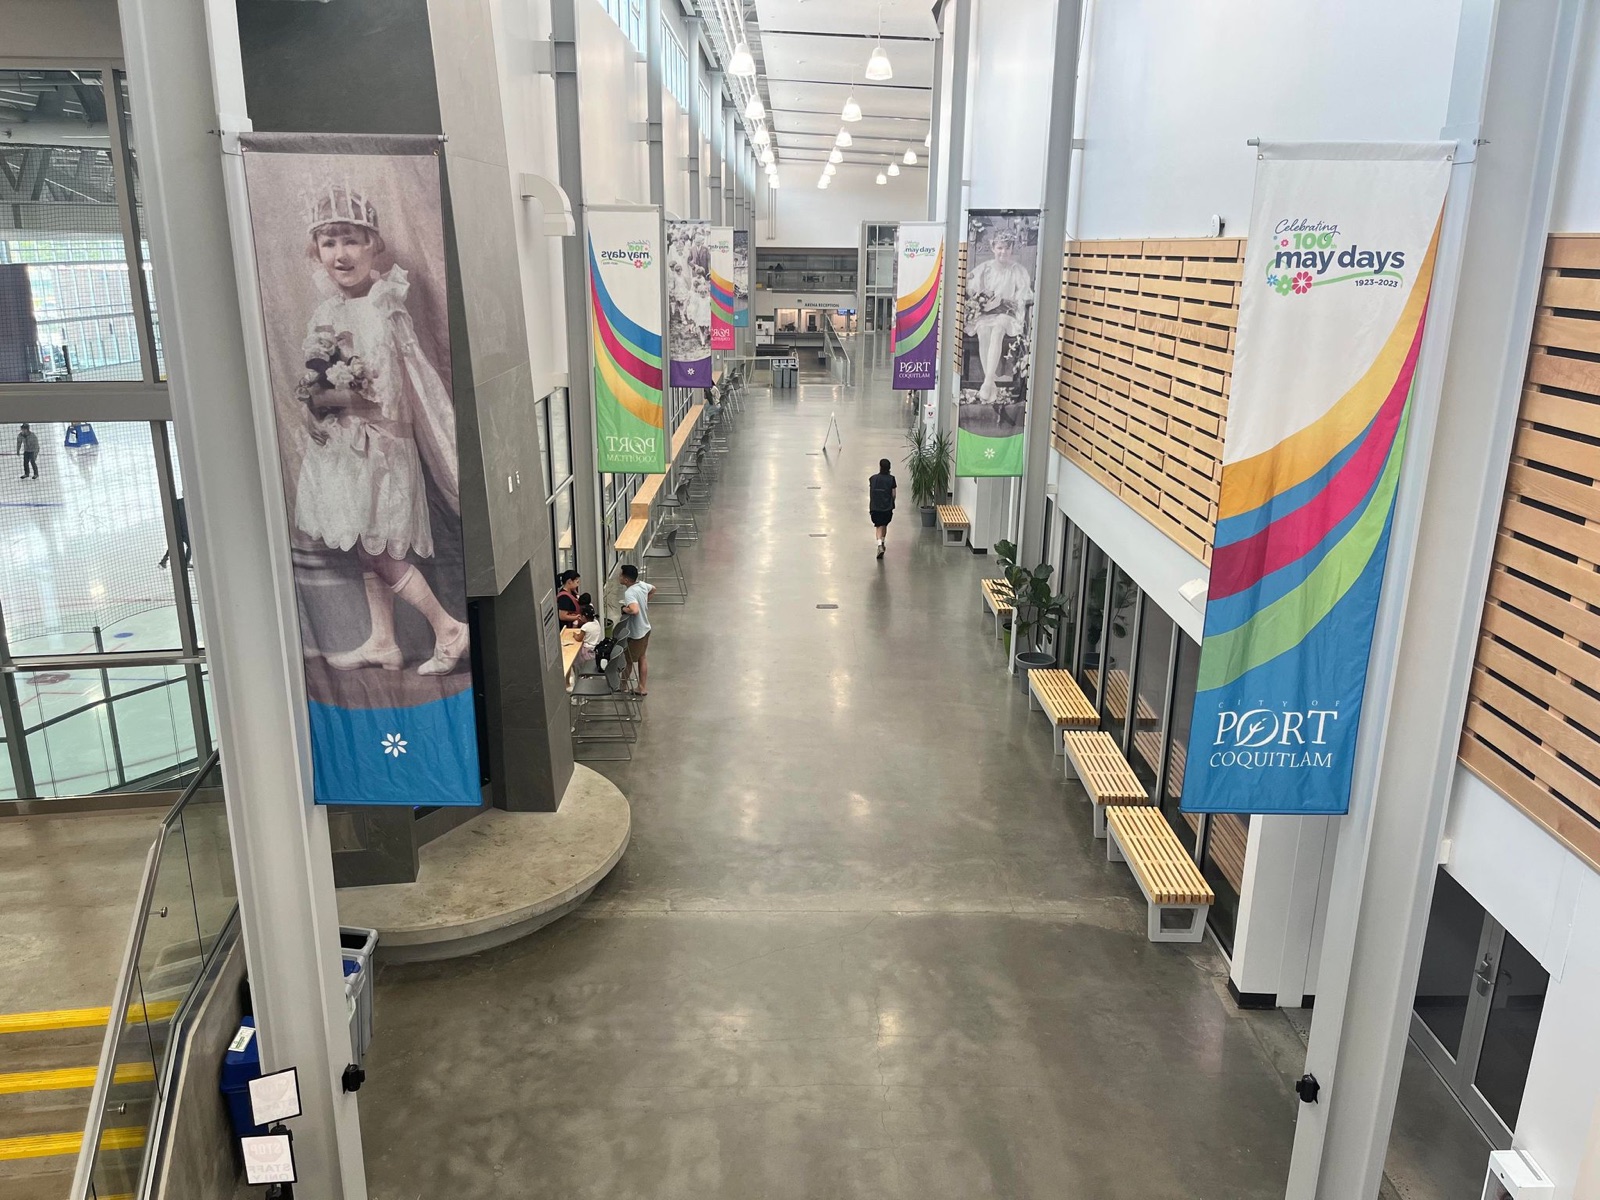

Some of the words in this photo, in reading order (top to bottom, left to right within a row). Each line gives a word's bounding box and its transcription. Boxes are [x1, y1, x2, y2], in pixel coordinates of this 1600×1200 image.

[1275, 219, 1340, 241] Celebrating
[1275, 251, 1335, 274] may
[1337, 245, 1405, 274] days
[900, 361, 930, 373] PORT
[1213, 709, 1338, 747] PORT
[1210, 751, 1333, 769] COQUITLAM
